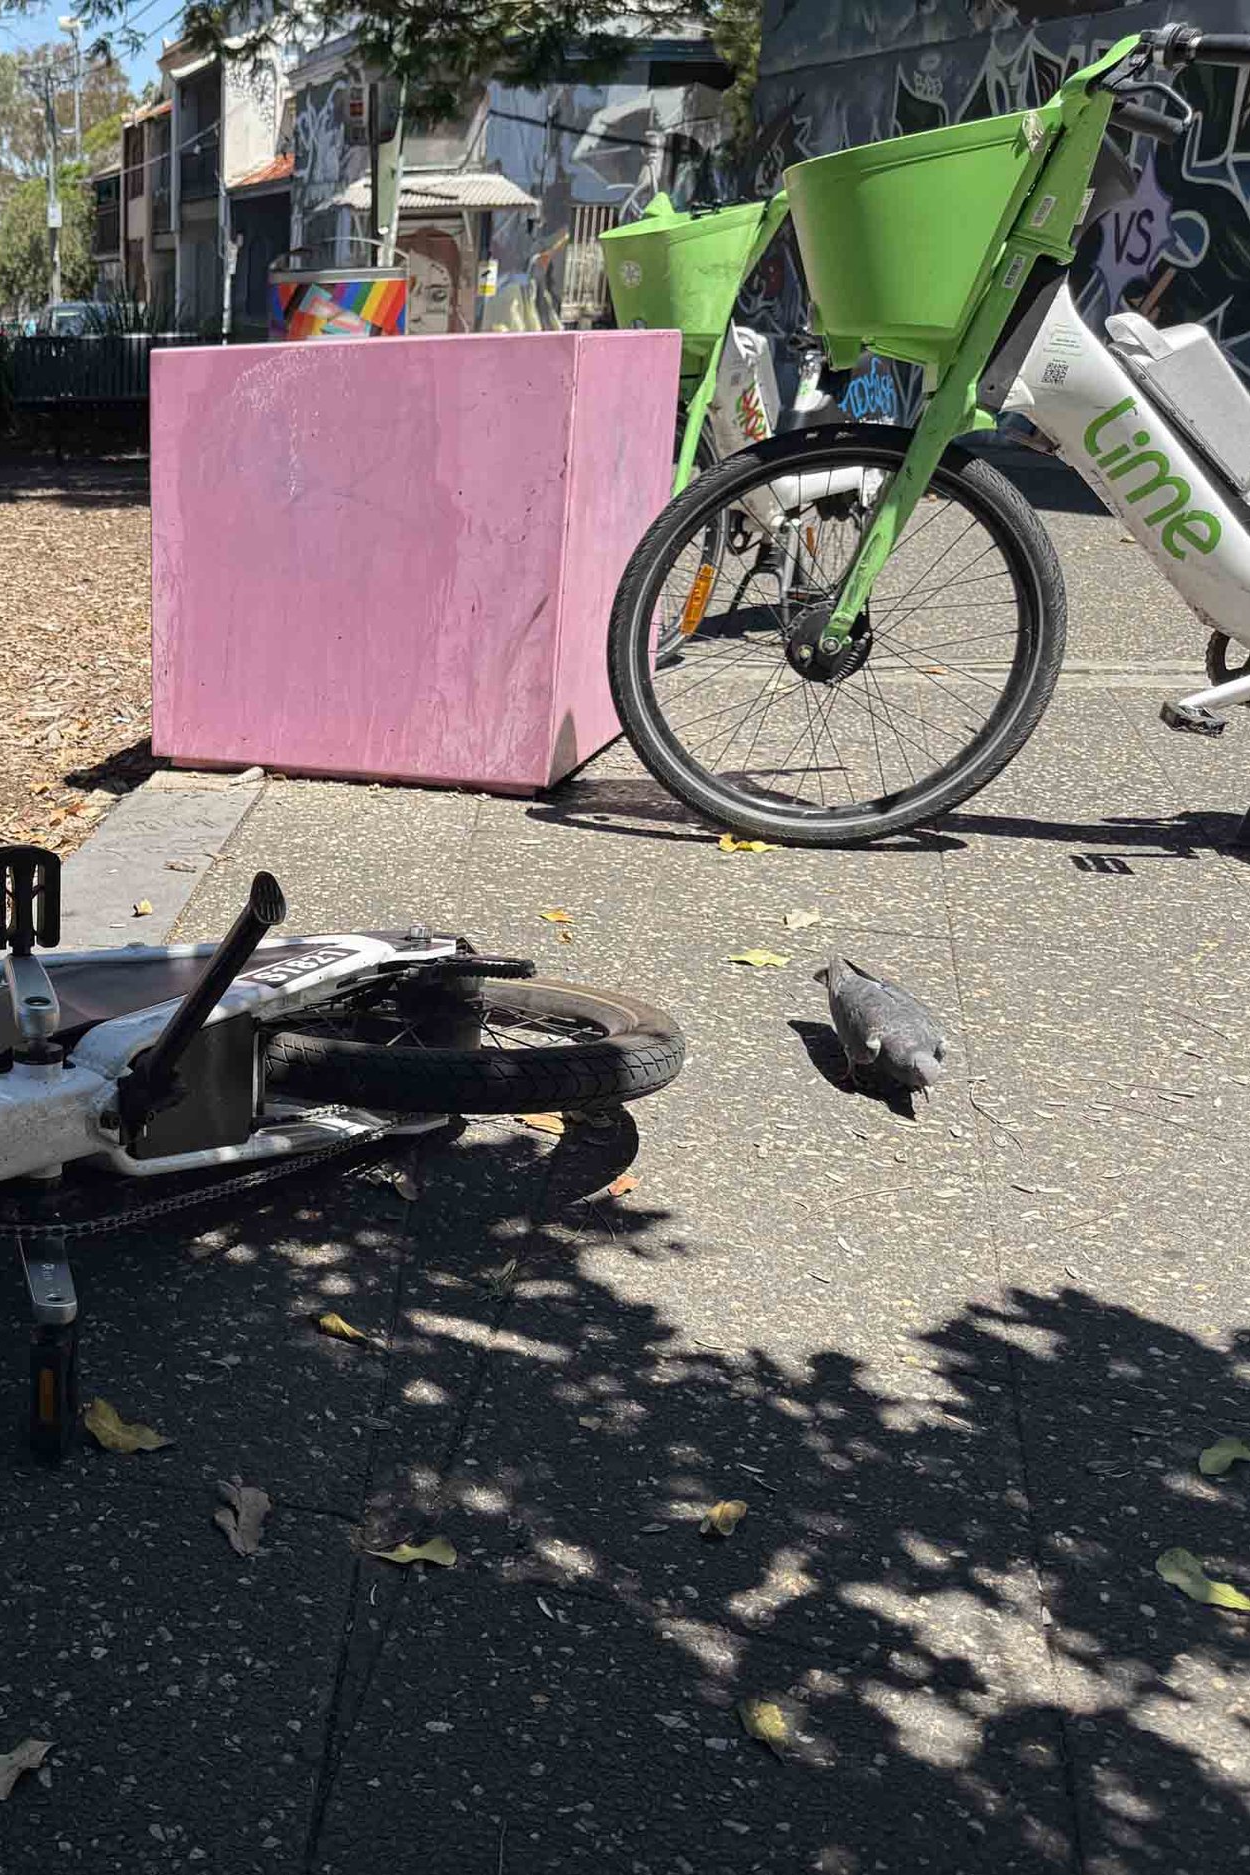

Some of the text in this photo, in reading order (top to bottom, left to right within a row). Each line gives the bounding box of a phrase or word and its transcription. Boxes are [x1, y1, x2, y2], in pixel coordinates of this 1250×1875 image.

[1114, 210, 1155, 266] VS
[1083, 395, 1222, 561] Lime
[253, 950, 349, 983] S1821
